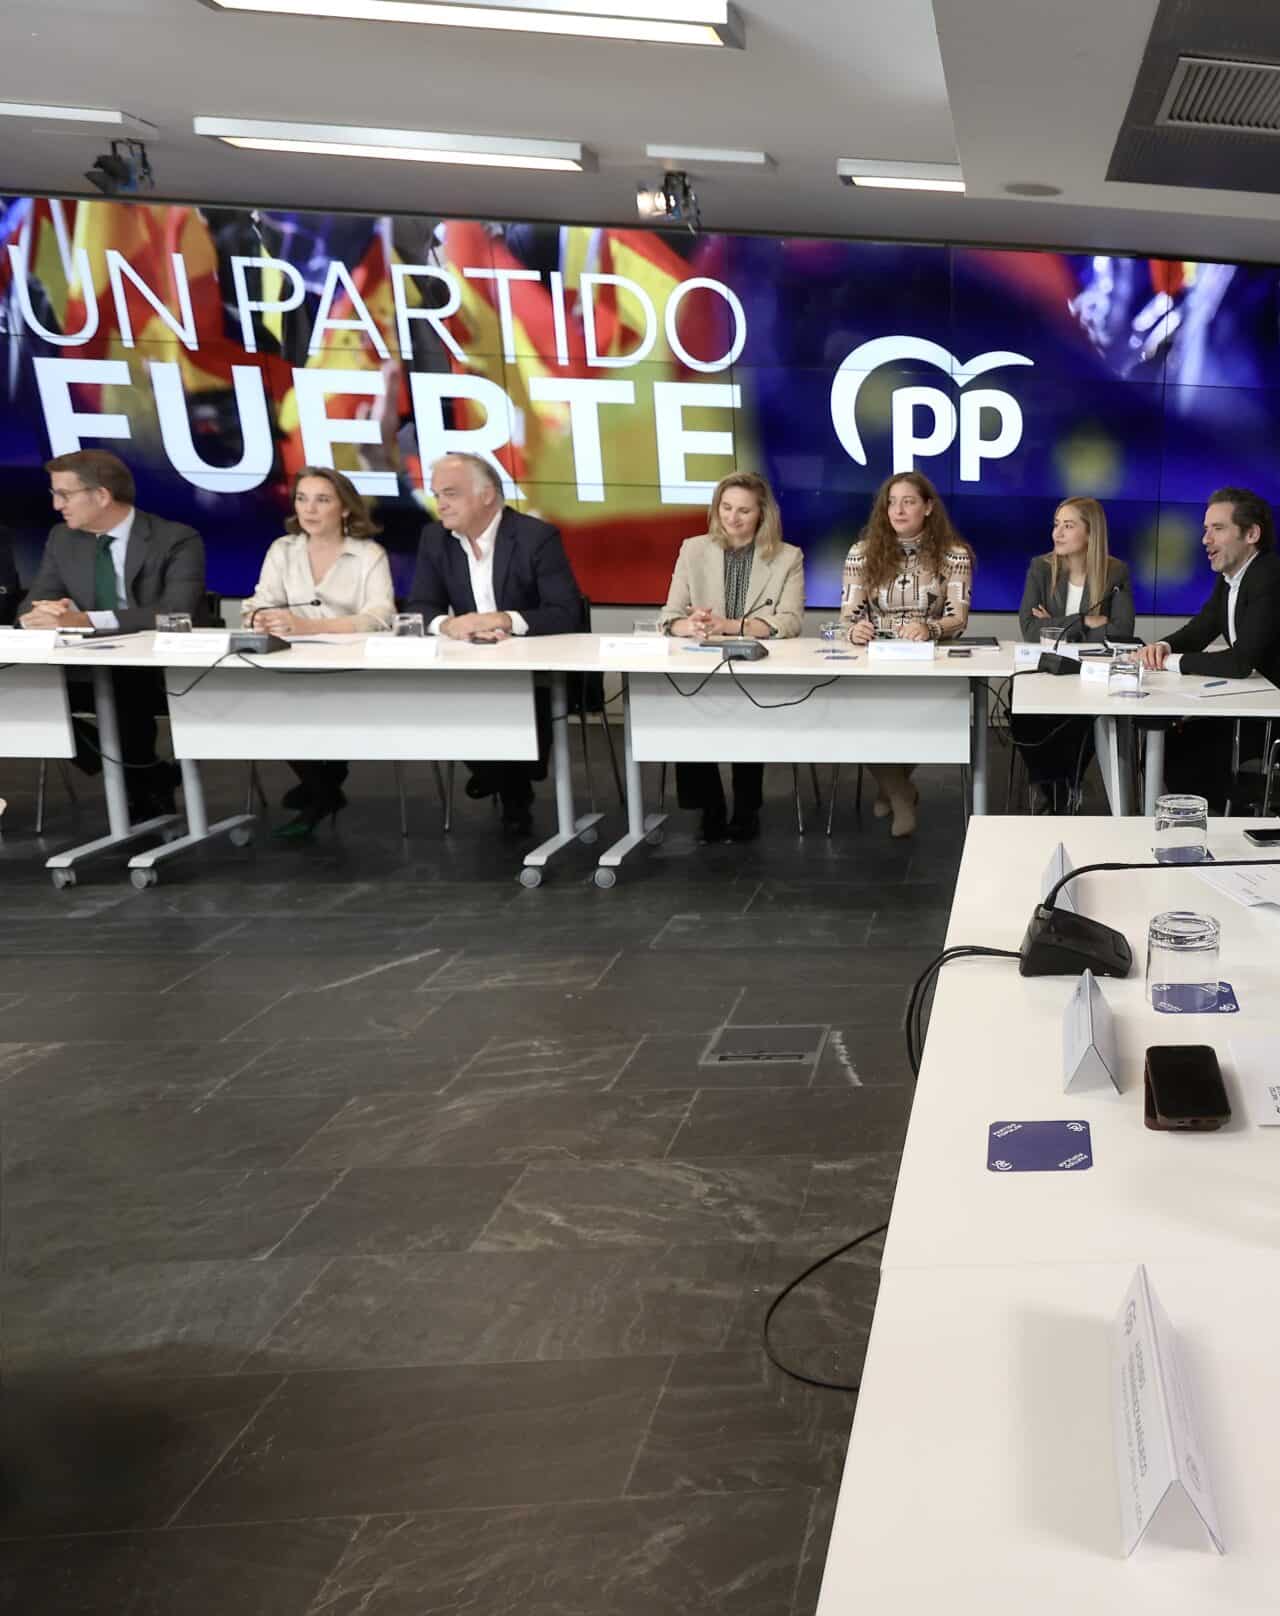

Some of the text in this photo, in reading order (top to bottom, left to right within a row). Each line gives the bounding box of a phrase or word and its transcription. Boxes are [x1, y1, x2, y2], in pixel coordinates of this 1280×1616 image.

[8, 245, 747, 373] UN PARTIDO
[33, 356, 743, 504] FUERTE
